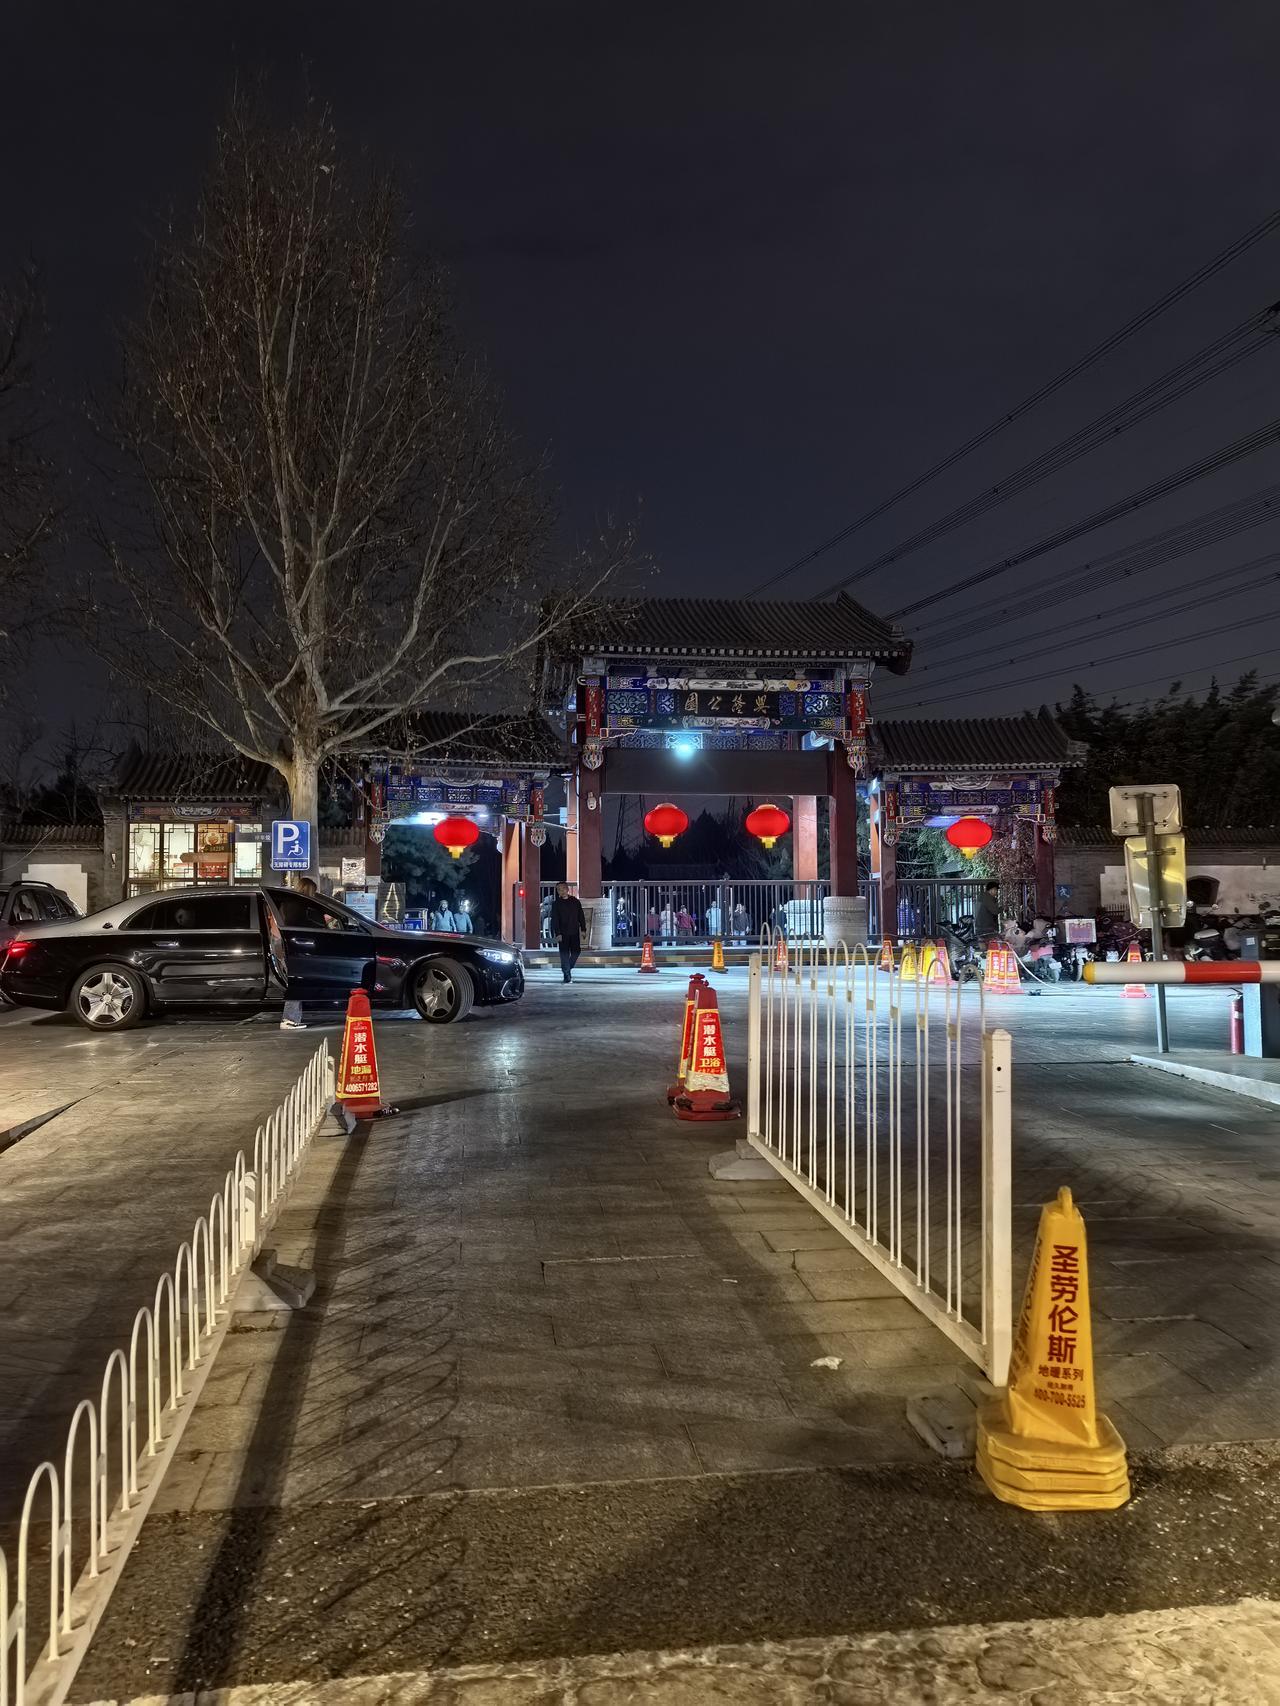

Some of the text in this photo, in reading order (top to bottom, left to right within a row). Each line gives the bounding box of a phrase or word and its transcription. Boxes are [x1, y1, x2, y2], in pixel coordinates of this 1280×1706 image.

[277, 823, 300, 854] P
[353, 1032, 368, 1065] 潜水艇
[703, 1024, 717, 1057] 潜水艇
[350, 1065, 372, 1075] 地漏
[699, 1058, 721, 1068] 卫浴
[1047, 1244, 1080, 1365] 圣劳伦斯
[1038, 1364, 1085, 1382] 地暖系列
